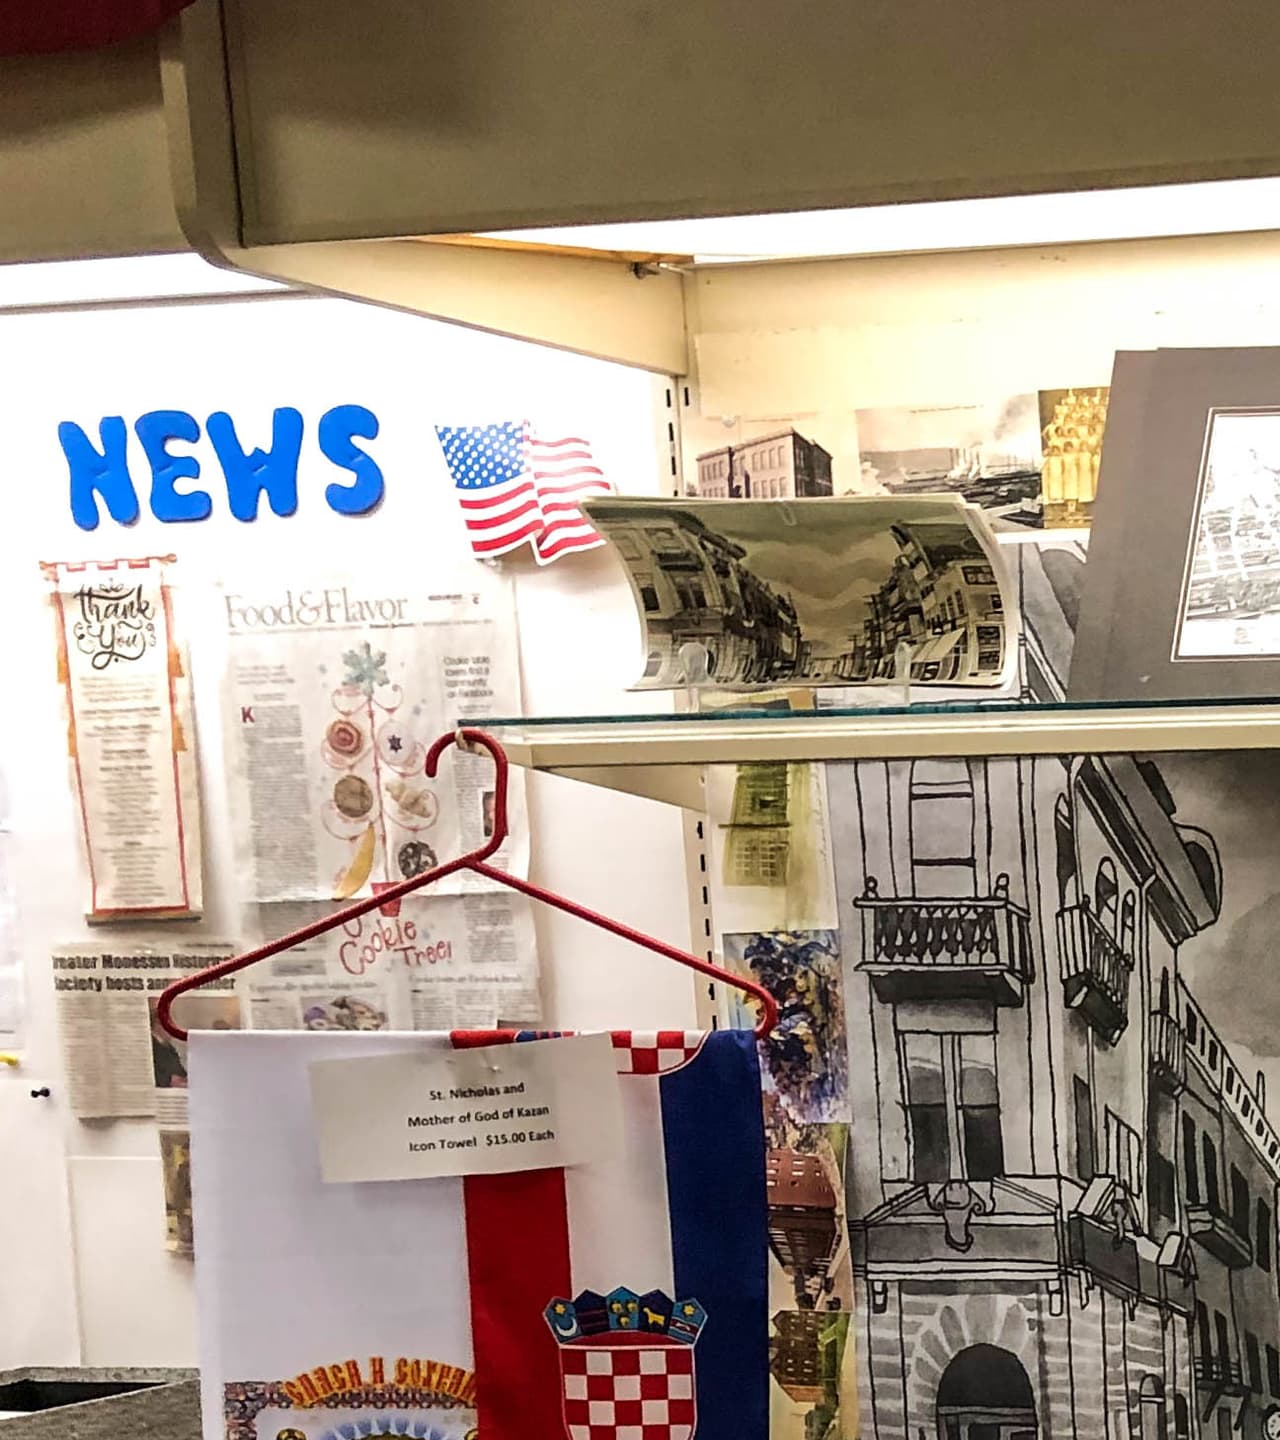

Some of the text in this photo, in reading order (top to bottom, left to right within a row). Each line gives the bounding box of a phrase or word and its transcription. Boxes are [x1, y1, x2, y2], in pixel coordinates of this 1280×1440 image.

[57, 404, 386, 531] NEWS
[340, 919, 417, 975] Cookie
[52, 955, 98, 969] reater
[430, 1082, 525, 1101] St. Nicholas and
[408, 1106, 549, 1127] Mother of God of Kazan
[409, 1129, 555, 1152] Icon Towel $15.00 Each
